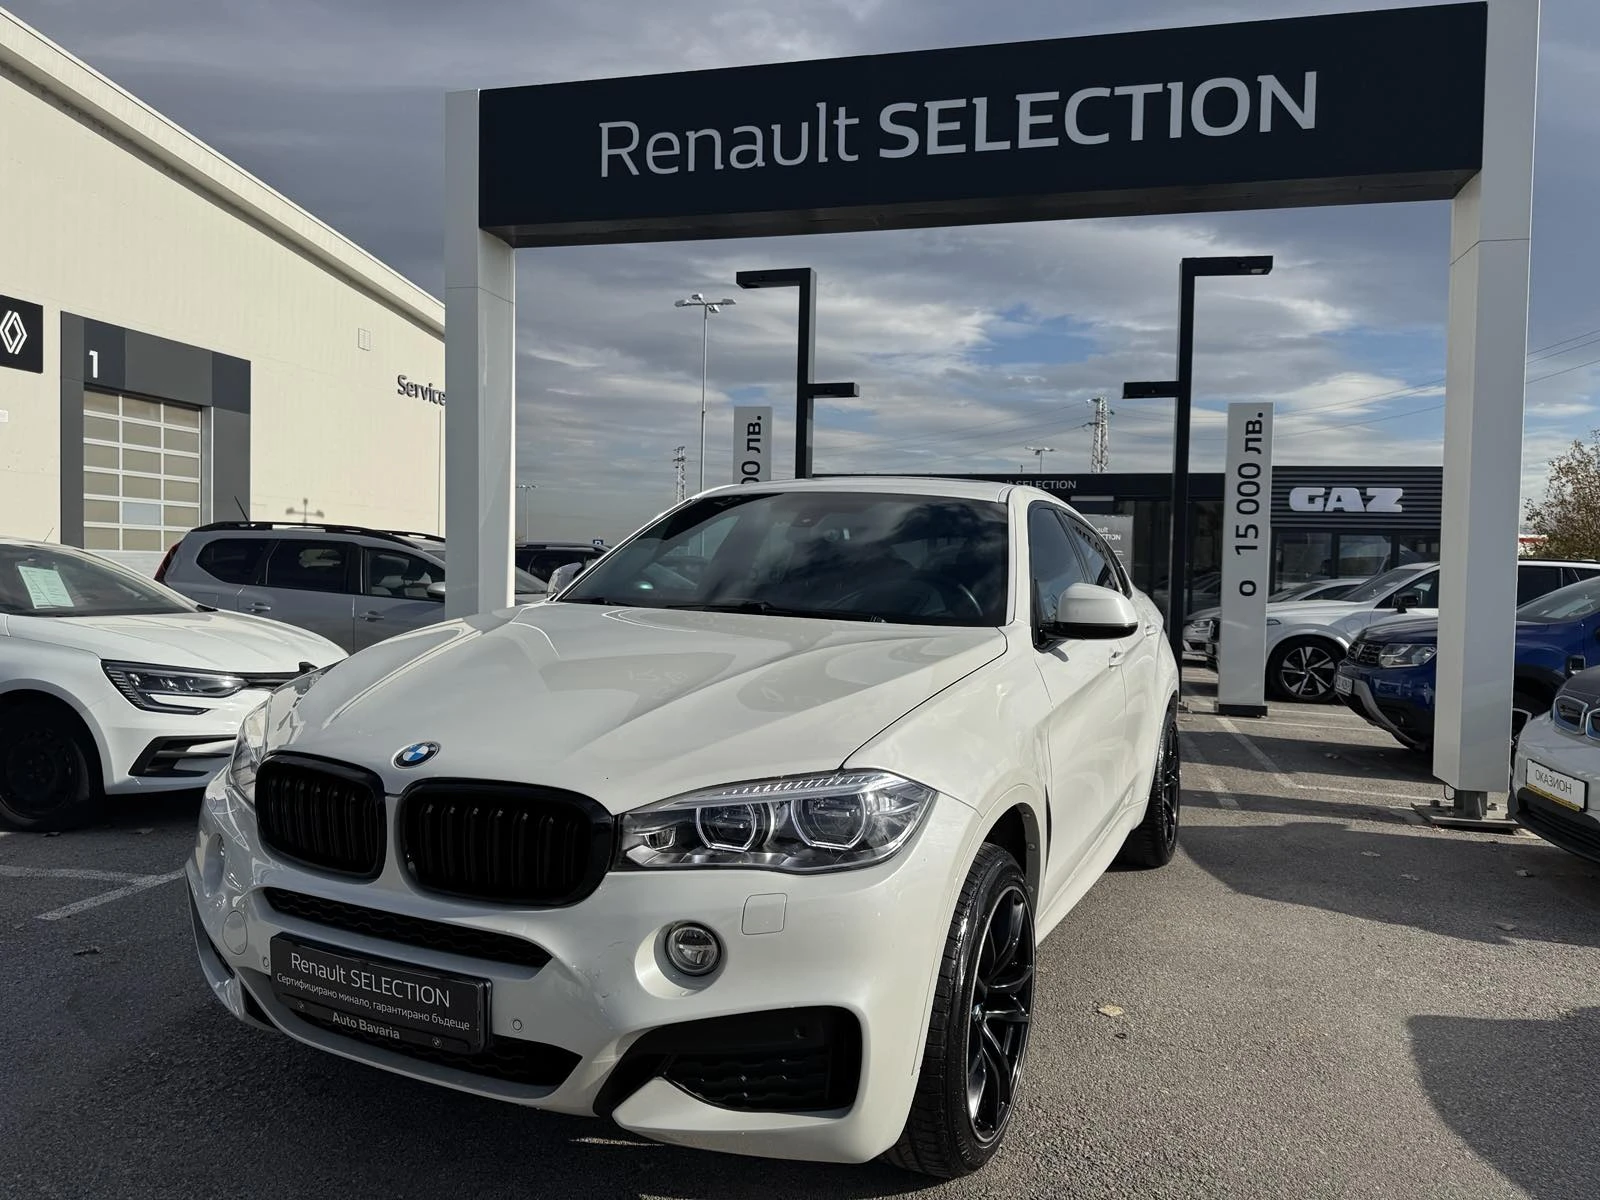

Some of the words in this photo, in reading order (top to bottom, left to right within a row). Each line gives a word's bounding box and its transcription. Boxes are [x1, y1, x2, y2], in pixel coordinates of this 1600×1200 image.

[599, 101, 860, 178] Renault
[879, 71, 1318, 160] SELECTION
[89, 350, 98, 378] 1
[397, 374, 445, 407] Service
[746, 415, 762, 453] лв.
[1245, 412, 1263, 454] лв.
[1236, 462, 1261, 515] 000
[1289, 487, 1403, 512] GAZ
[1234, 524, 1259, 556] 15
[1535, 769, 1572, 794] ОКАЗИОН
[290, 952, 347, 985] Renault
[350, 969, 450, 1008] SELECTION
[276, 972, 338, 999] Сертифицирано
[338, 993, 372, 1009] минало,
[372, 1002, 430, 1022] гарантирано
[431, 1013, 470, 1031] бъдеще
[332, 1012, 357, 1029] Auto
[358, 1018, 401, 1040] Bavaria
